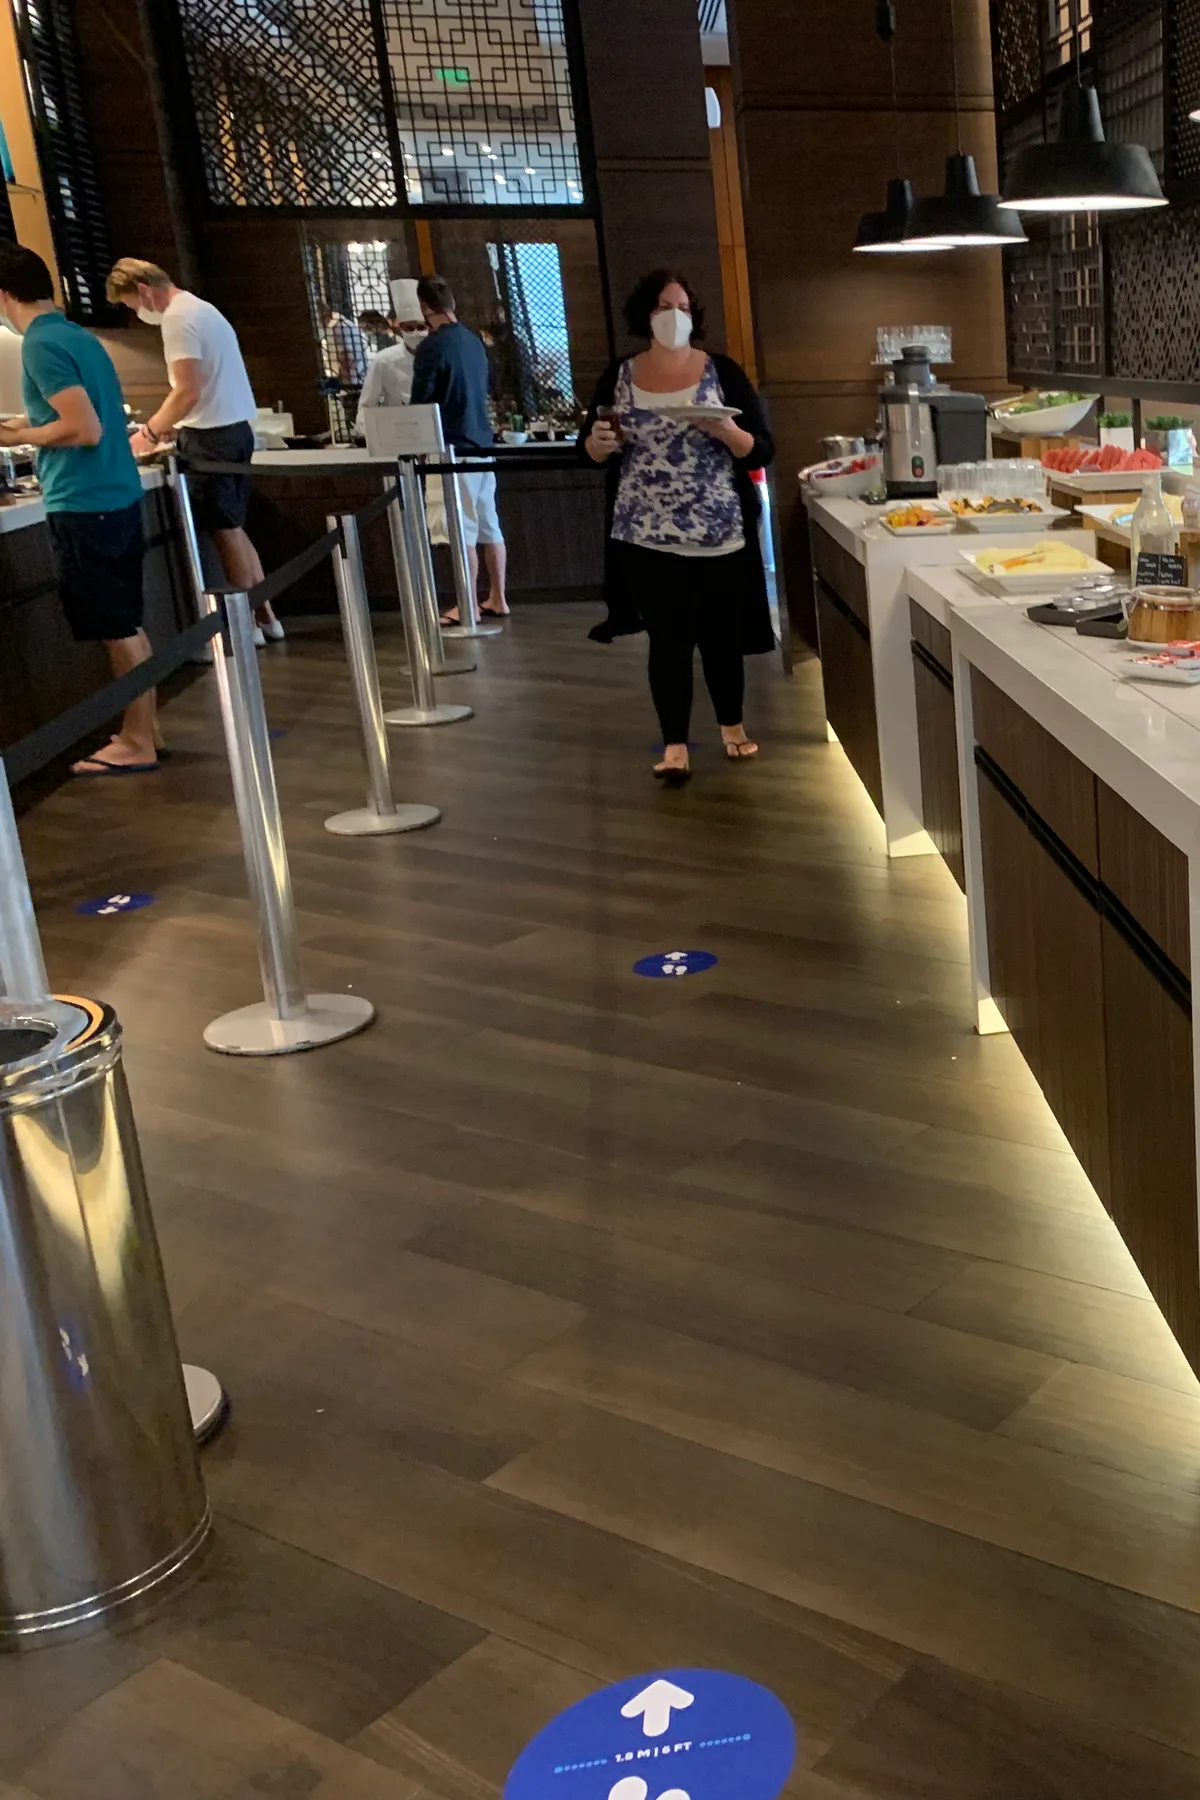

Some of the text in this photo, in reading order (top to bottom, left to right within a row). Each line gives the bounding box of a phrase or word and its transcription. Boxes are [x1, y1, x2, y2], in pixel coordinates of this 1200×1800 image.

[615, 1752, 633, 1762] 1.8
[637, 1748, 651, 1759] M
[661, 1745, 671, 1755] 6
[674, 1741, 692, 1752] FT
